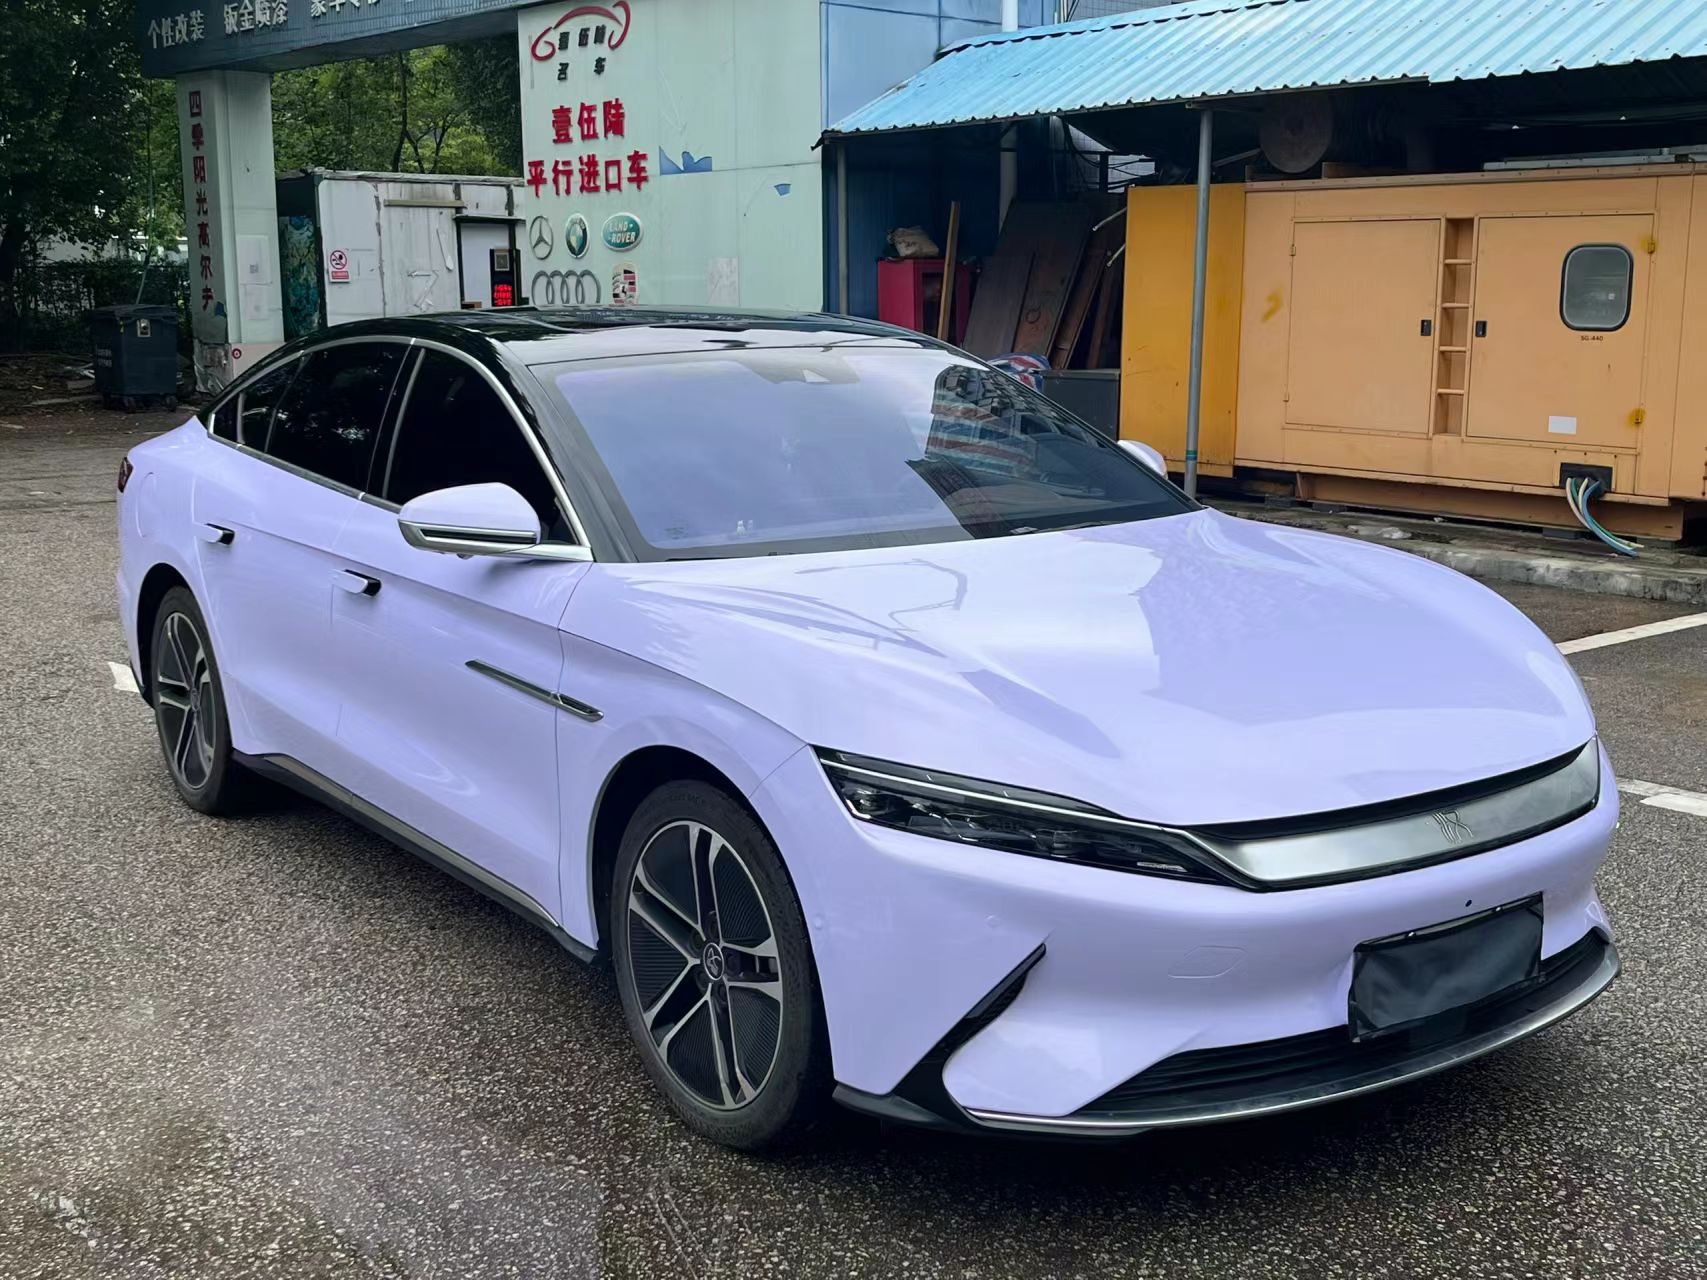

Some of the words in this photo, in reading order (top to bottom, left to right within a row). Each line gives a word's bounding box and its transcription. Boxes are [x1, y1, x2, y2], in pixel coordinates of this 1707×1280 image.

[148, 9, 205, 49] 个性改装
[552, 98, 625, 144] 壹伍陆
[527, 150, 649, 197] 平行进口车
[609, 221, 628, 231] LAND
[611, 232, 636, 243] ROVER
